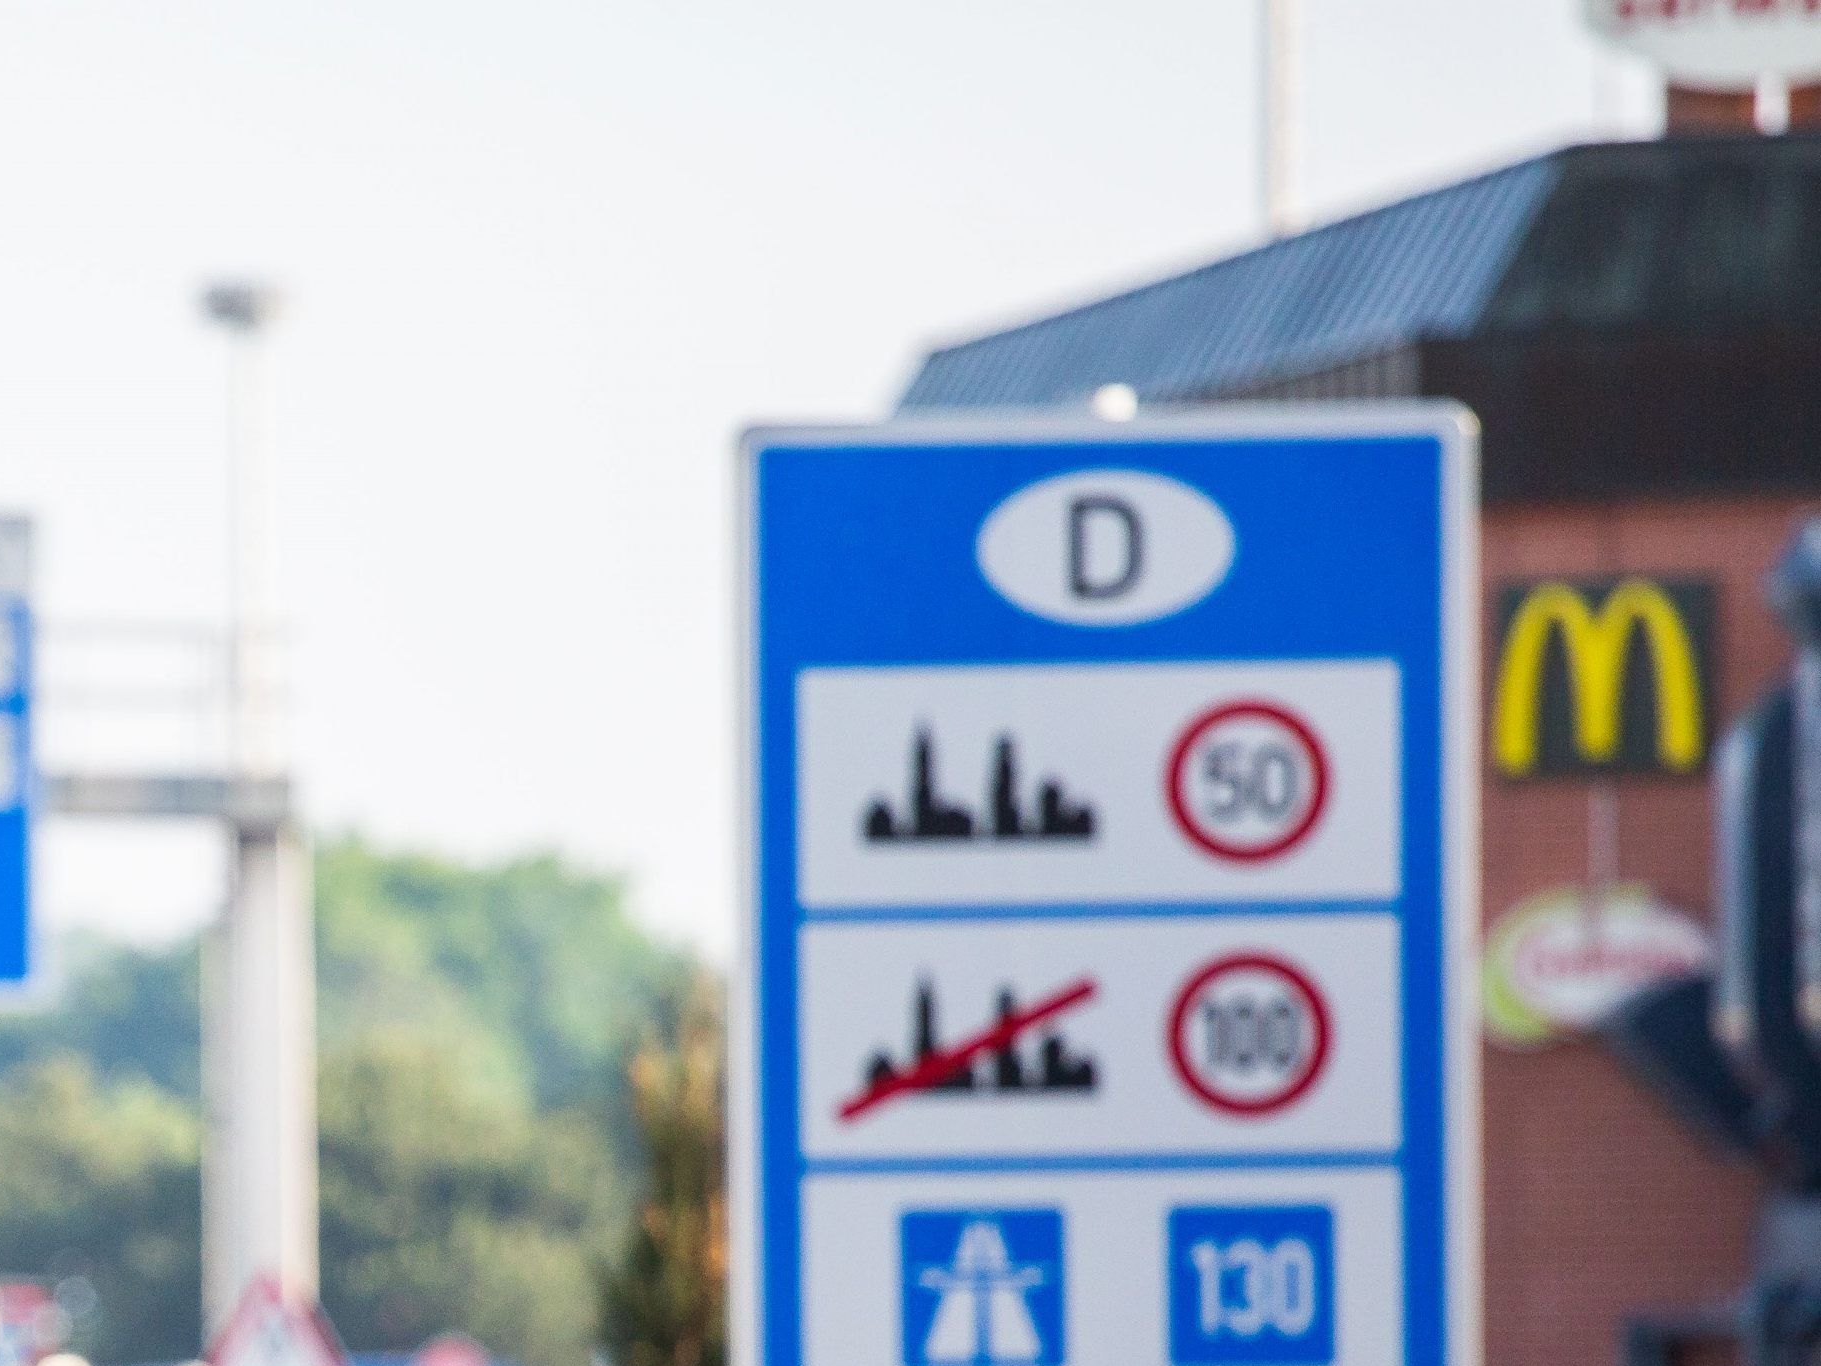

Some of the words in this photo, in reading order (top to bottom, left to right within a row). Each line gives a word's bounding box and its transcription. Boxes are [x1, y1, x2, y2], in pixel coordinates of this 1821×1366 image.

[1067, 493, 1144, 602] D
[1198, 741, 1299, 825] 50
[1201, 998, 1303, 1072] 100
[1189, 1236, 1316, 1338] 130
